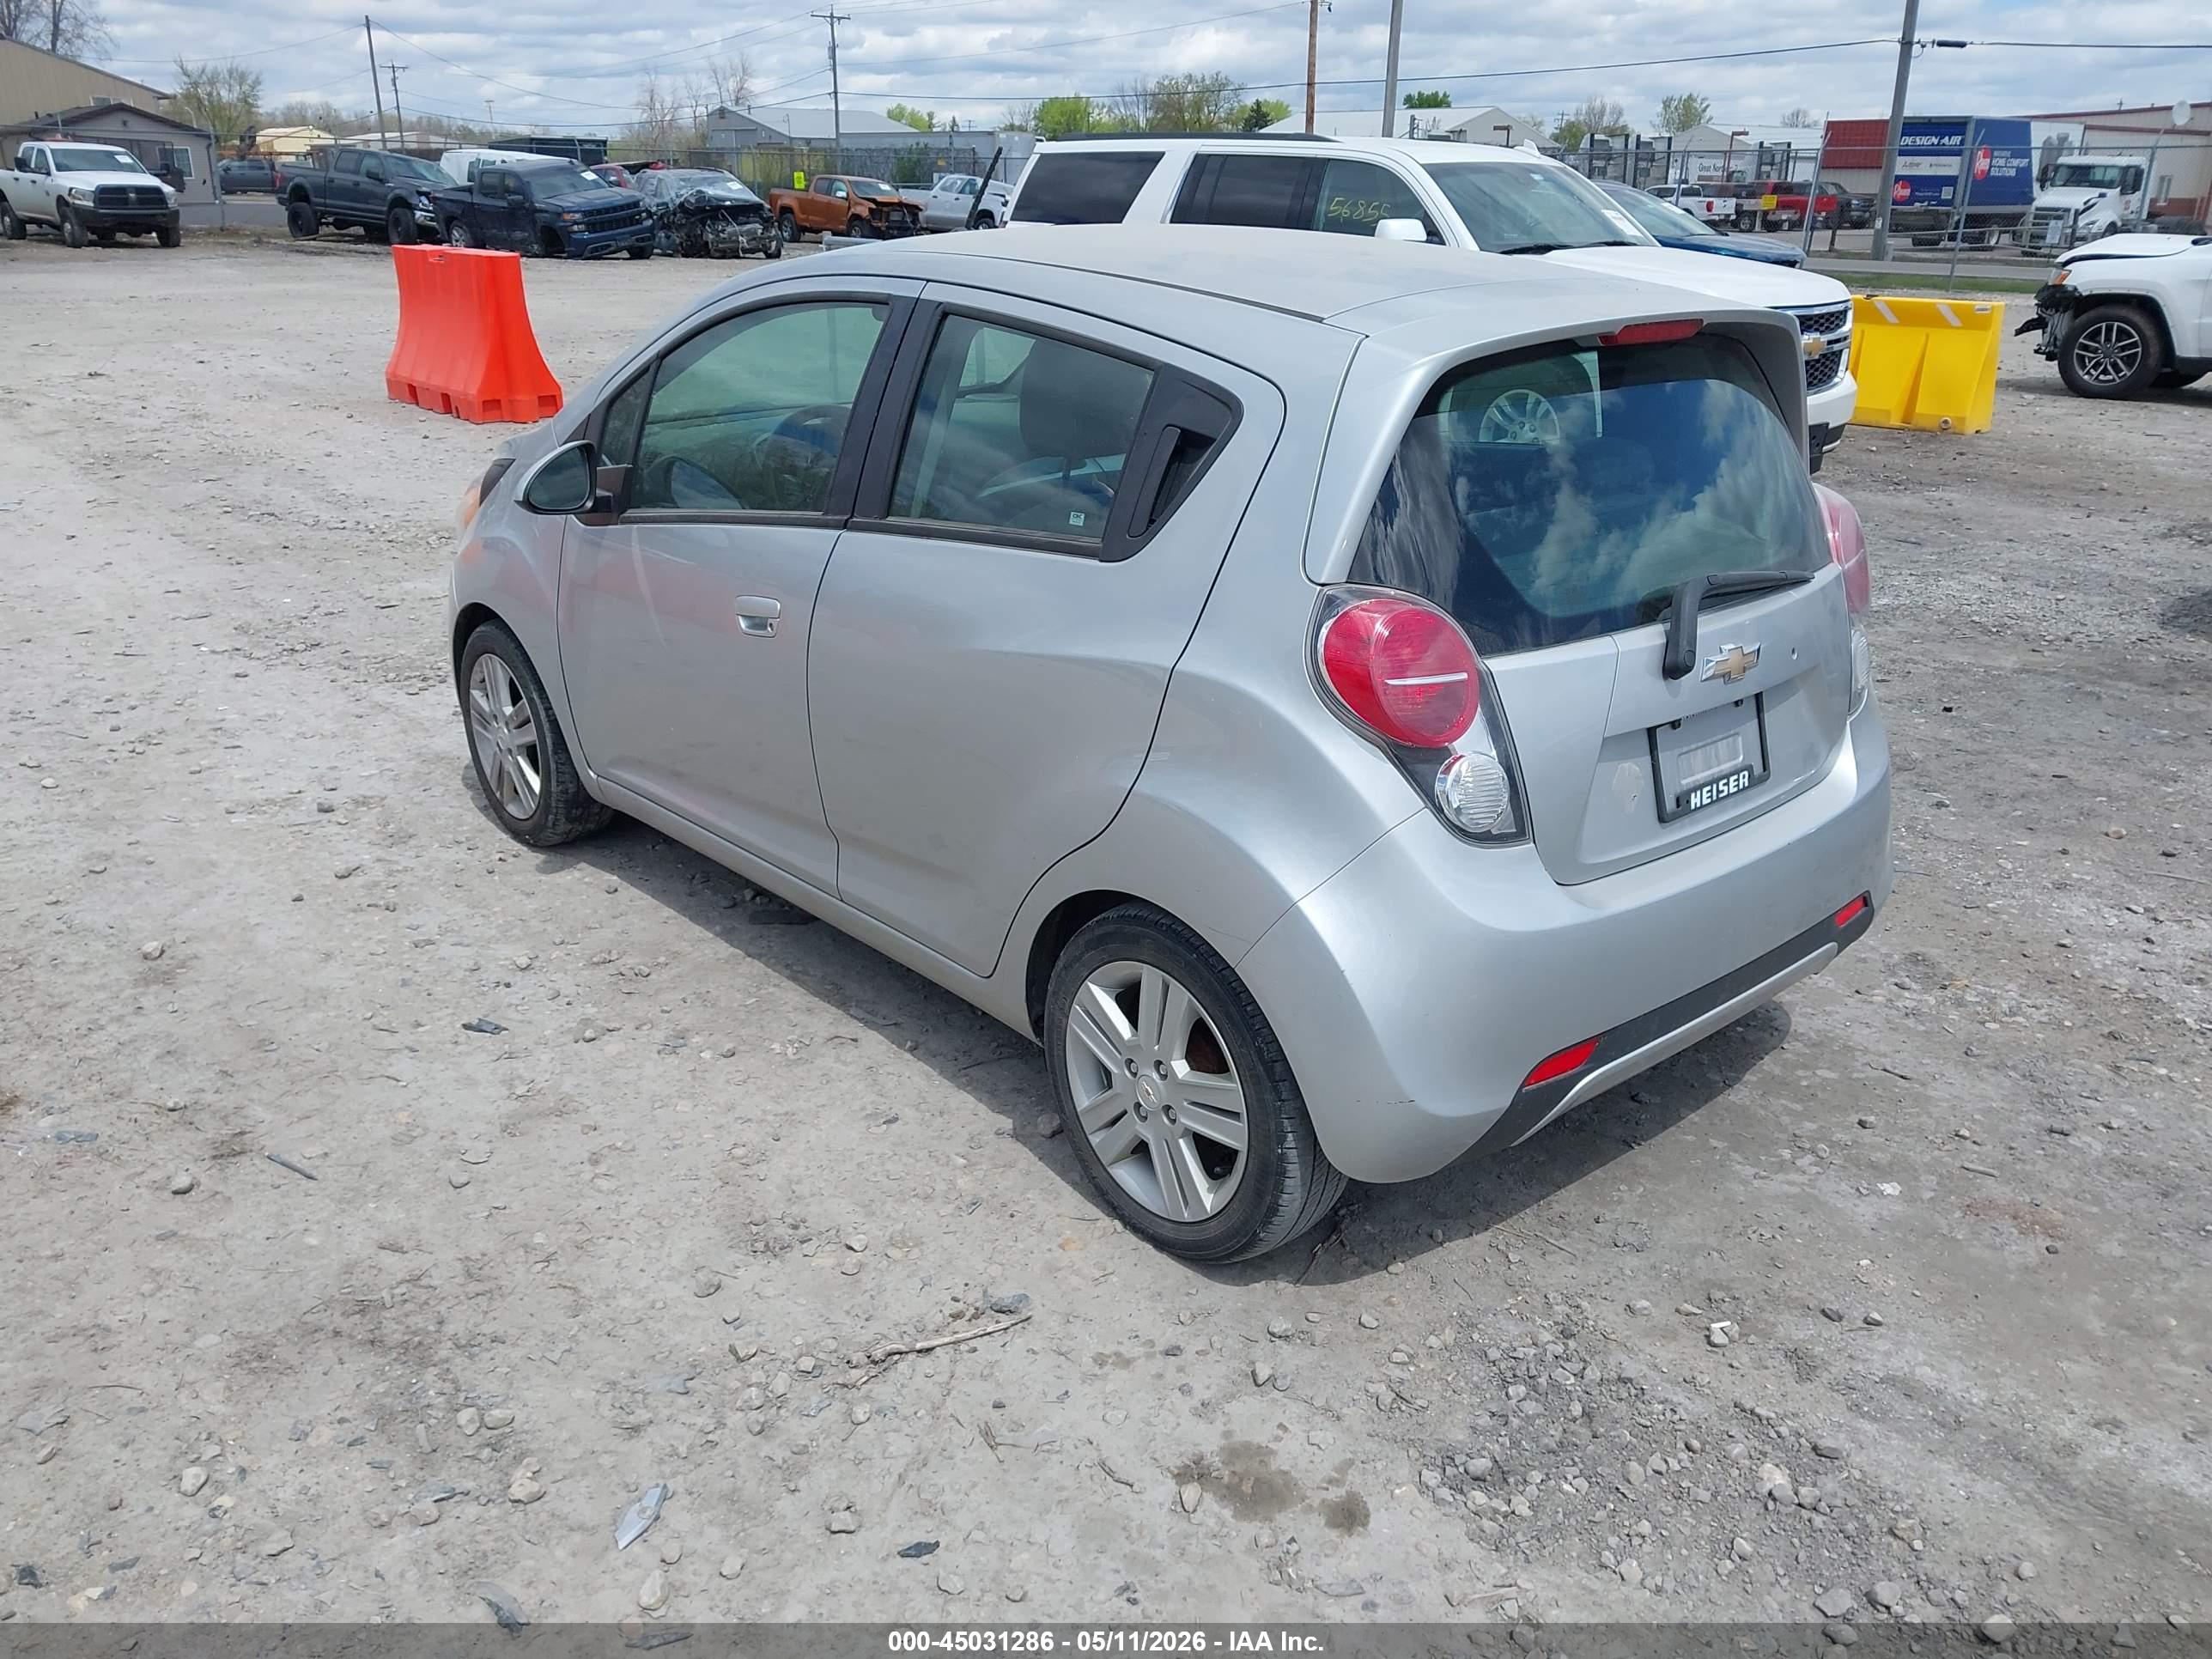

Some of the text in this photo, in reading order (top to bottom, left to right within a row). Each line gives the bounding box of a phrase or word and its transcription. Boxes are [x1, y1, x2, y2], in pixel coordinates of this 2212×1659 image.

[1900, 136, 1962, 146] DESIGN AIR
[1328, 198, 1391, 225] 56855
[1690, 770, 1748, 810] HEISER
